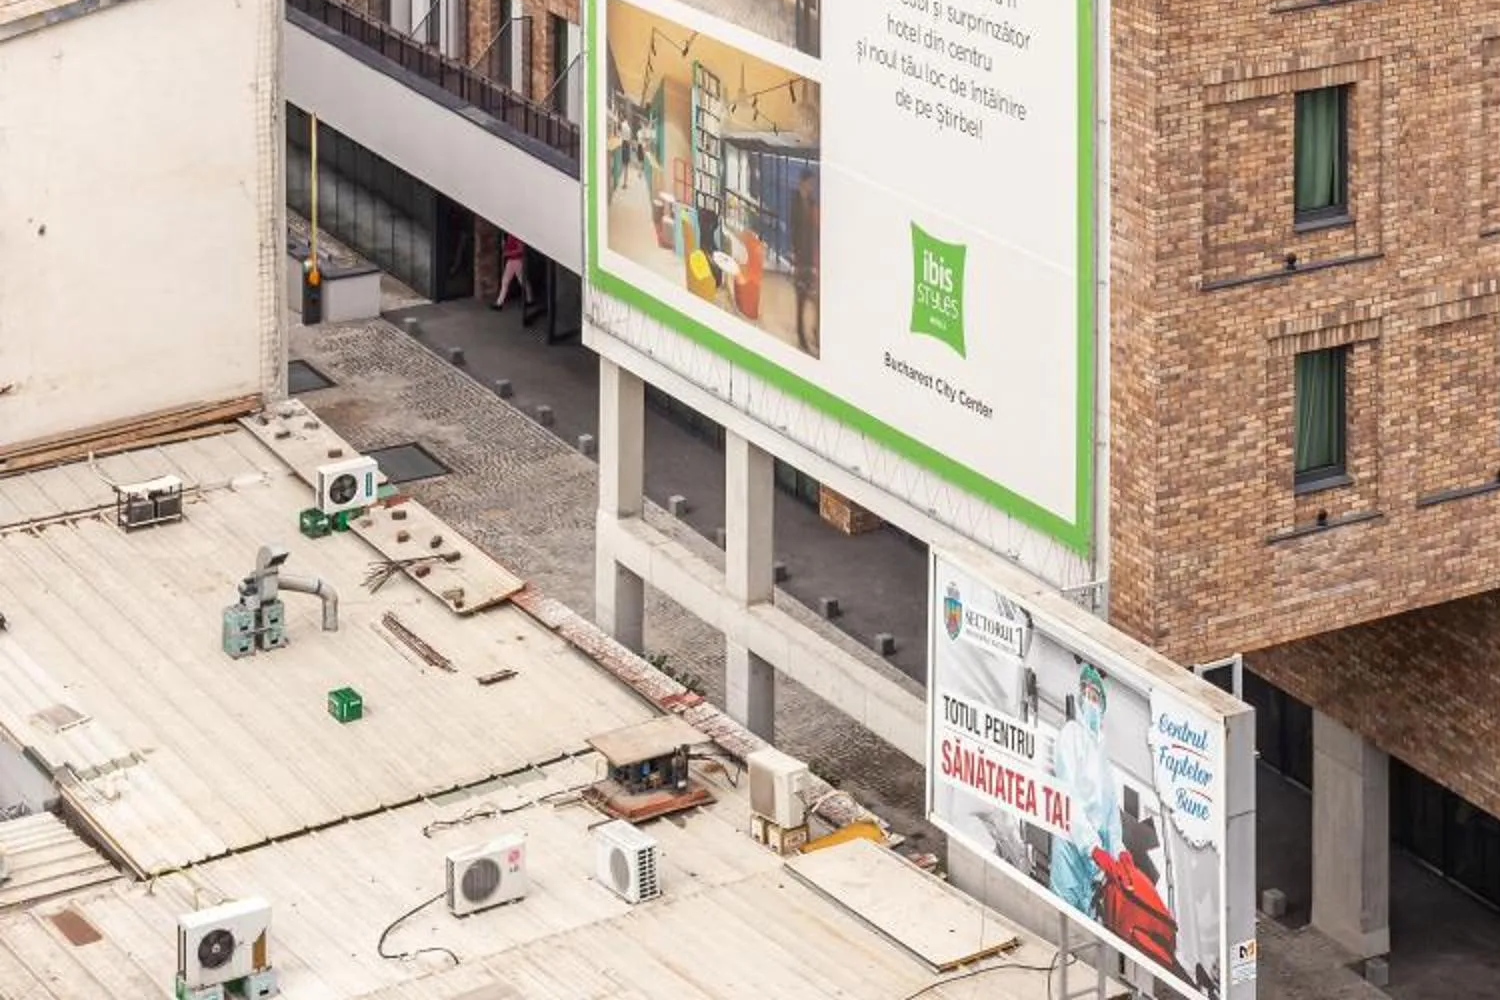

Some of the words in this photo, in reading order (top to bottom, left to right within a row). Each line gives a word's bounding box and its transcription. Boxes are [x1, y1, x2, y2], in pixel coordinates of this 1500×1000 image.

[887, 12, 921, 45] hotel
[924, 27, 945, 55] din
[948, 42, 993, 73] centru
[947, 5, 1032, 51] surprinzător
[870, 45, 898, 71] noul
[925, 62, 946, 89] loc
[949, 74, 967, 98] de
[895, 87, 913, 111] de
[915, 98, 933, 120] pe
[923, 248, 953, 293] ibis
[884, 351, 933, 390] Bucharest
[936, 377, 957, 403] City
[959, 389, 993, 420] Center
[943, 694, 981, 736] TOTUL
[984, 713, 1036, 760] PENTRU
[1159, 712, 1210, 751] Centrul
[941, 737, 1038, 817] SĂNĂTATEA
[1042, 785, 1071, 833] TA!
[1159, 745, 1214, 787] Faptelor
[1175, 787, 1211, 821] Bune
